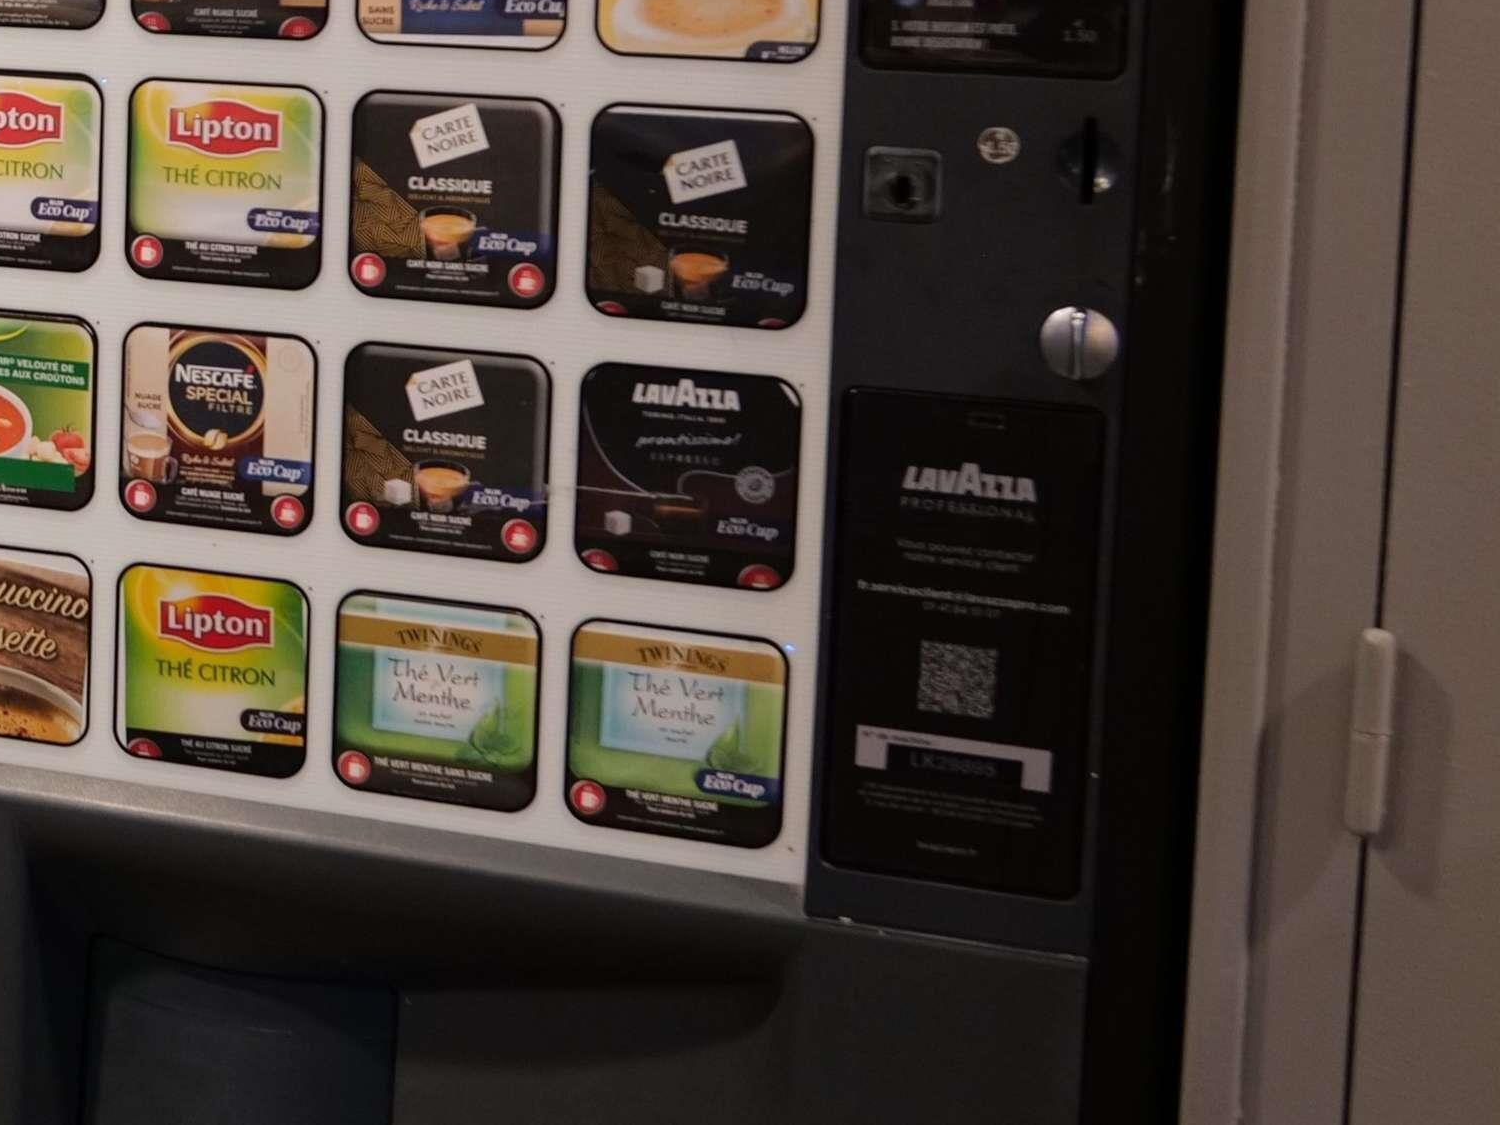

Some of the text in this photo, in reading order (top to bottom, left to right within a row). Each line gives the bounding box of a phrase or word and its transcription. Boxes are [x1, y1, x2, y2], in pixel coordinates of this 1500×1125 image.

[177, 112, 272, 144] Lipton
[422, 115, 475, 141] CARTE
[427, 132, 477, 155] NOIRE
[676, 152, 730, 176] CARTE
[163, 165, 283, 190] THÉ CITRON
[408, 176, 493, 194] CLASSIQUE
[680, 168, 735, 190] NOIRE
[658, 212, 748, 234] CLASSIQUE
[12, 369, 31, 379] AUX
[17, 359, 58, 371] VELOUTÉ
[61, 363, 74, 373] DE
[418, 371, 468, 394] CARTE
[185, 386, 253, 405] SPECIAL
[422, 387, 471, 409] NOIRE
[403, 429, 487, 450] CLASSIQUE
[167, 605, 265, 638] Lipton
[396, 629, 484, 654] TWININGS
[636, 646, 730, 672] TWININGS
[156, 658, 275, 686] THÉ CITRON
[436, 663, 481, 686] Vert
[393, 681, 471, 710] Menthe
[679, 677, 724, 702] Vert
[632, 697, 716, 726] Menthe
